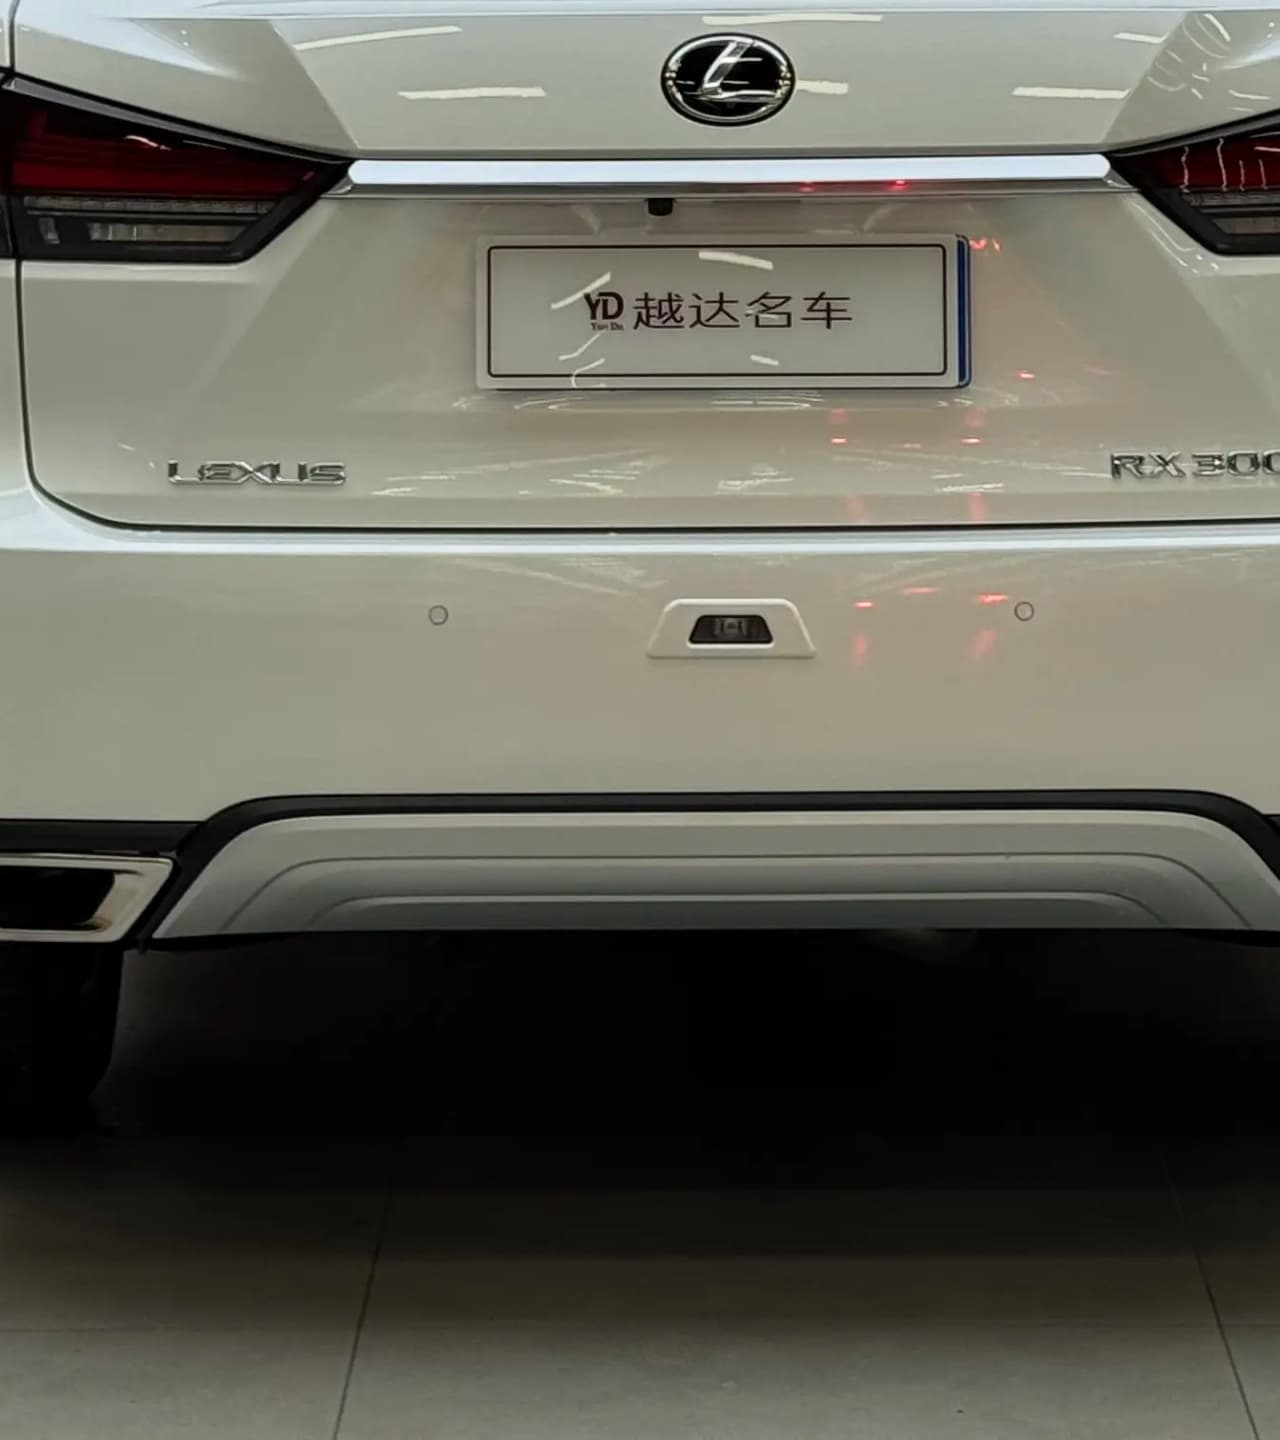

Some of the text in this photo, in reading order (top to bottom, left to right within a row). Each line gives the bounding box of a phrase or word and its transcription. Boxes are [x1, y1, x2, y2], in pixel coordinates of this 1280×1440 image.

[584, 292, 624, 320] YD
[632, 291, 853, 330] 越达名车
[168, 460, 346, 486] LEXUS
[1111, 452, 1186, 479] RX
